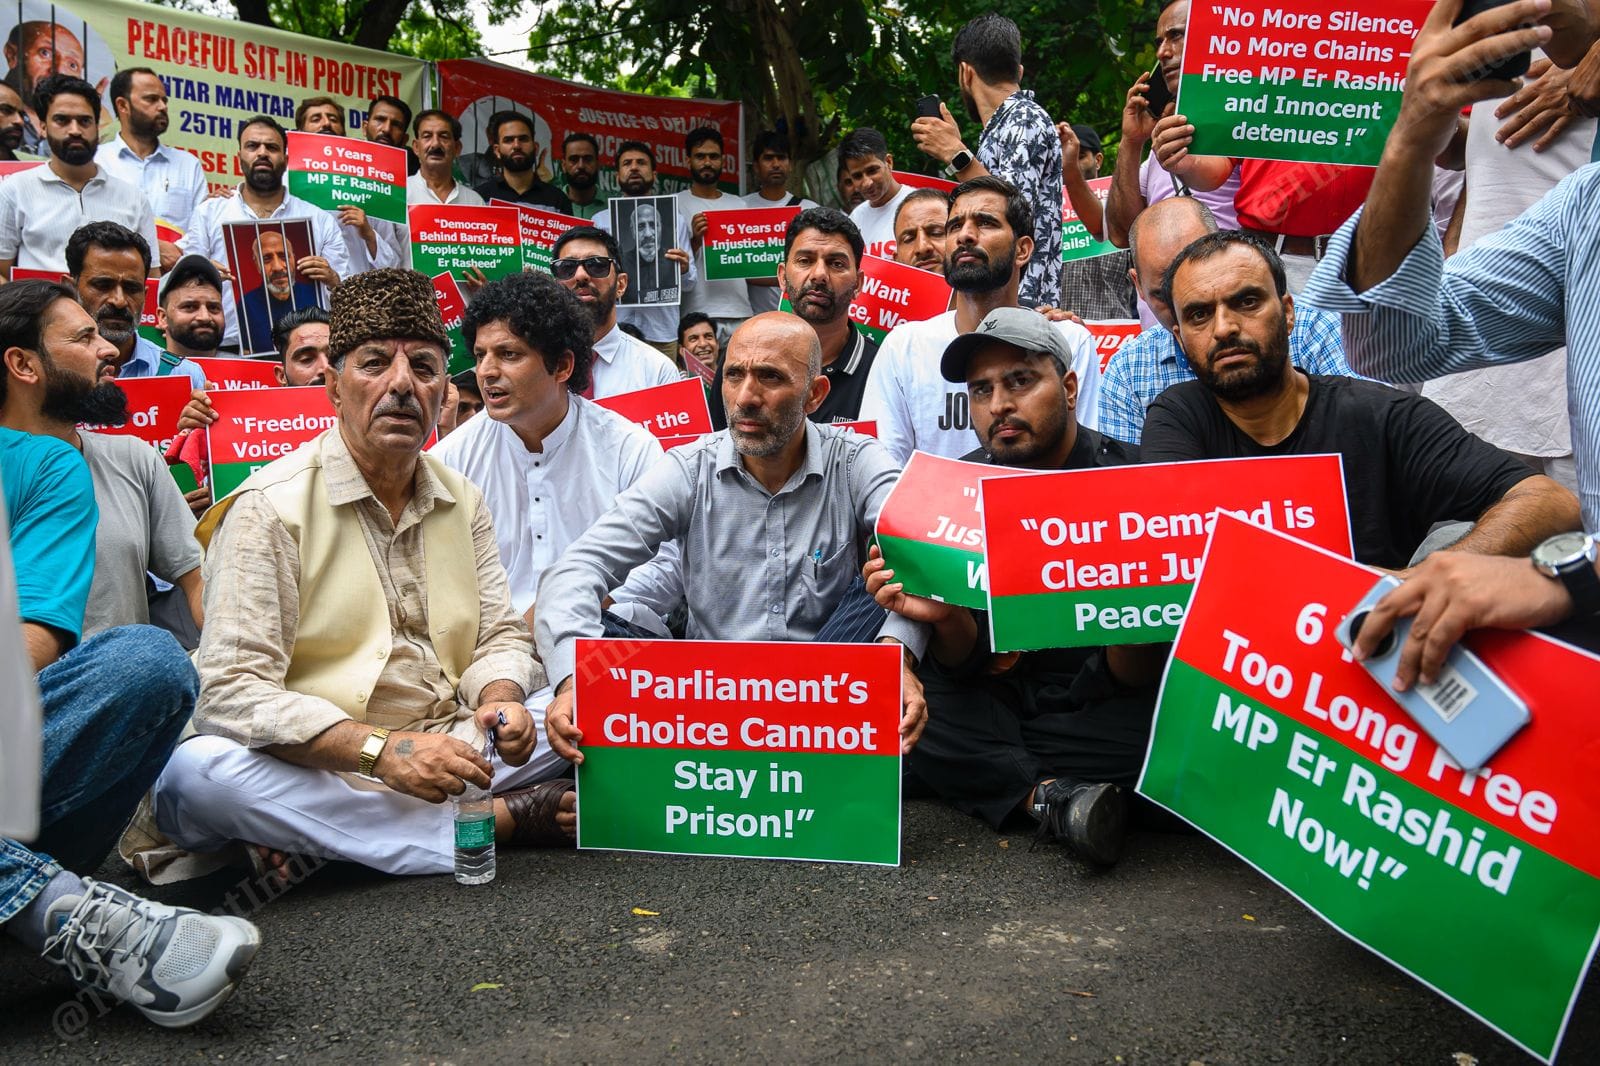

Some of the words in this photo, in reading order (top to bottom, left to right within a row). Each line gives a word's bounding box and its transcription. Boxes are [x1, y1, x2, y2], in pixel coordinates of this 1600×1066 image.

[1262, 9, 1322, 30] More
[1328, 11, 1419, 39] Silence,
[127, 18, 239, 75] PEACEFUL
[244, 42, 308, 88] SIT-IN
[313, 59, 402, 101] PROTEST
[1208, 35, 1240, 56] No
[1247, 37, 1307, 58] More
[1313, 40, 1394, 63] Chains
[1202, 64, 1253, 85] Free
[1260, 66, 1295, 86] MP
[1302, 69, 1328, 88] Er
[158, 75, 210, 104] NTAR
[215, 84, 295, 119] MANTAR
[1225, 94, 1269, 113] and
[1274, 95, 1383, 120] Innocent
[180, 110, 232, 139] 25TH
[1232, 122, 1339, 146] detenues
[323, 146, 333, 156] 6
[335, 147, 373, 162] Years
[302, 158, 329, 170] Too
[332, 161, 365, 177] Long
[367, 166, 394, 182] Free
[307, 173, 328, 185] MP
[332, 175, 347, 186] Er
[350, 177, 392, 195] Rashid
[420, 231, 459, 242] Behind
[460, 232, 489, 243] Bars?
[491, 234, 514, 244] Free
[736, 222, 770, 234] Years
[771, 221, 787, 233] of
[469, 245, 497, 256] Voice
[498, 246, 515, 256] MP
[712, 239, 765, 252] Injustice
[767, 237, 786, 247] Mu
[720, 254, 743, 265] End
[745, 251, 785, 264] Today!
[437, 257, 449, 267] Er
[861, 276, 911, 306] Want
[132, 406, 159, 427] of
[656, 411, 690, 429] the
[938, 391, 974, 431] JO
[232, 440, 293, 458] Voice
[1283, 500, 1316, 529] is
[927, 515, 984, 548] Jus
[1041, 559, 1148, 591] Clear:
[1160, 552, 1202, 583] Ju
[1294, 602, 1328, 645] 6
[1222, 629, 1294, 699] Too
[1302, 672, 1419, 773] Long
[603, 713, 728, 746] Choice
[740, 717, 878, 751] Cannot
[674, 760, 757, 798] Stay
[769, 762, 803, 794] in
[1211, 692, 1279, 752] MP
[1286, 731, 1338, 788] Er
[1342, 762, 1522, 897] Rashid
